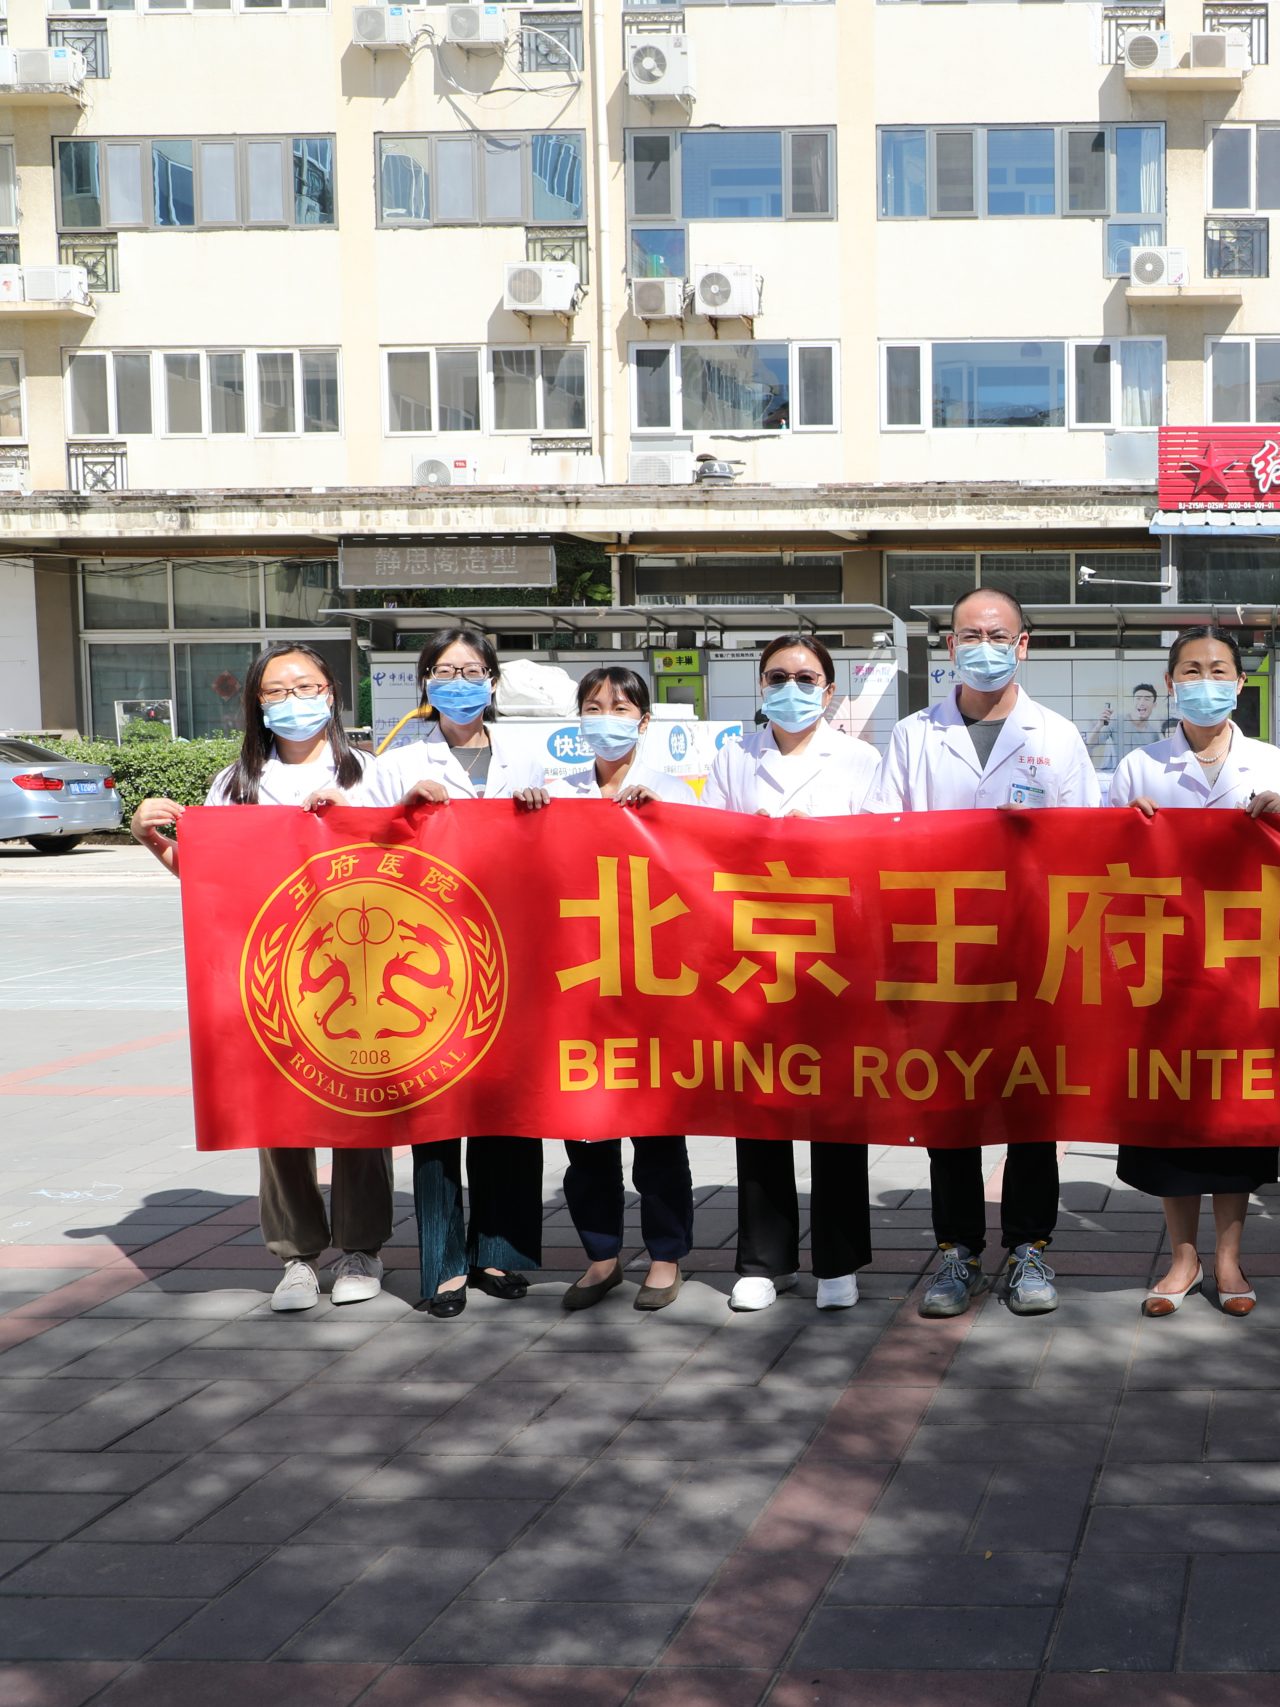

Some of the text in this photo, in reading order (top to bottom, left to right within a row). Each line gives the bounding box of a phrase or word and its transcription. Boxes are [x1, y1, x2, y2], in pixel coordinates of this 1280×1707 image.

[675, 655, 693, 665] 丰巢
[289, 853, 460, 911] 王府医院
[289, 1048, 467, 1103] ROYAL HOSPITAL
[350, 1050, 391, 1065] 2008
[559, 1038, 821, 1096] BEIJING
[853, 1046, 1091, 1100] ROYAL
